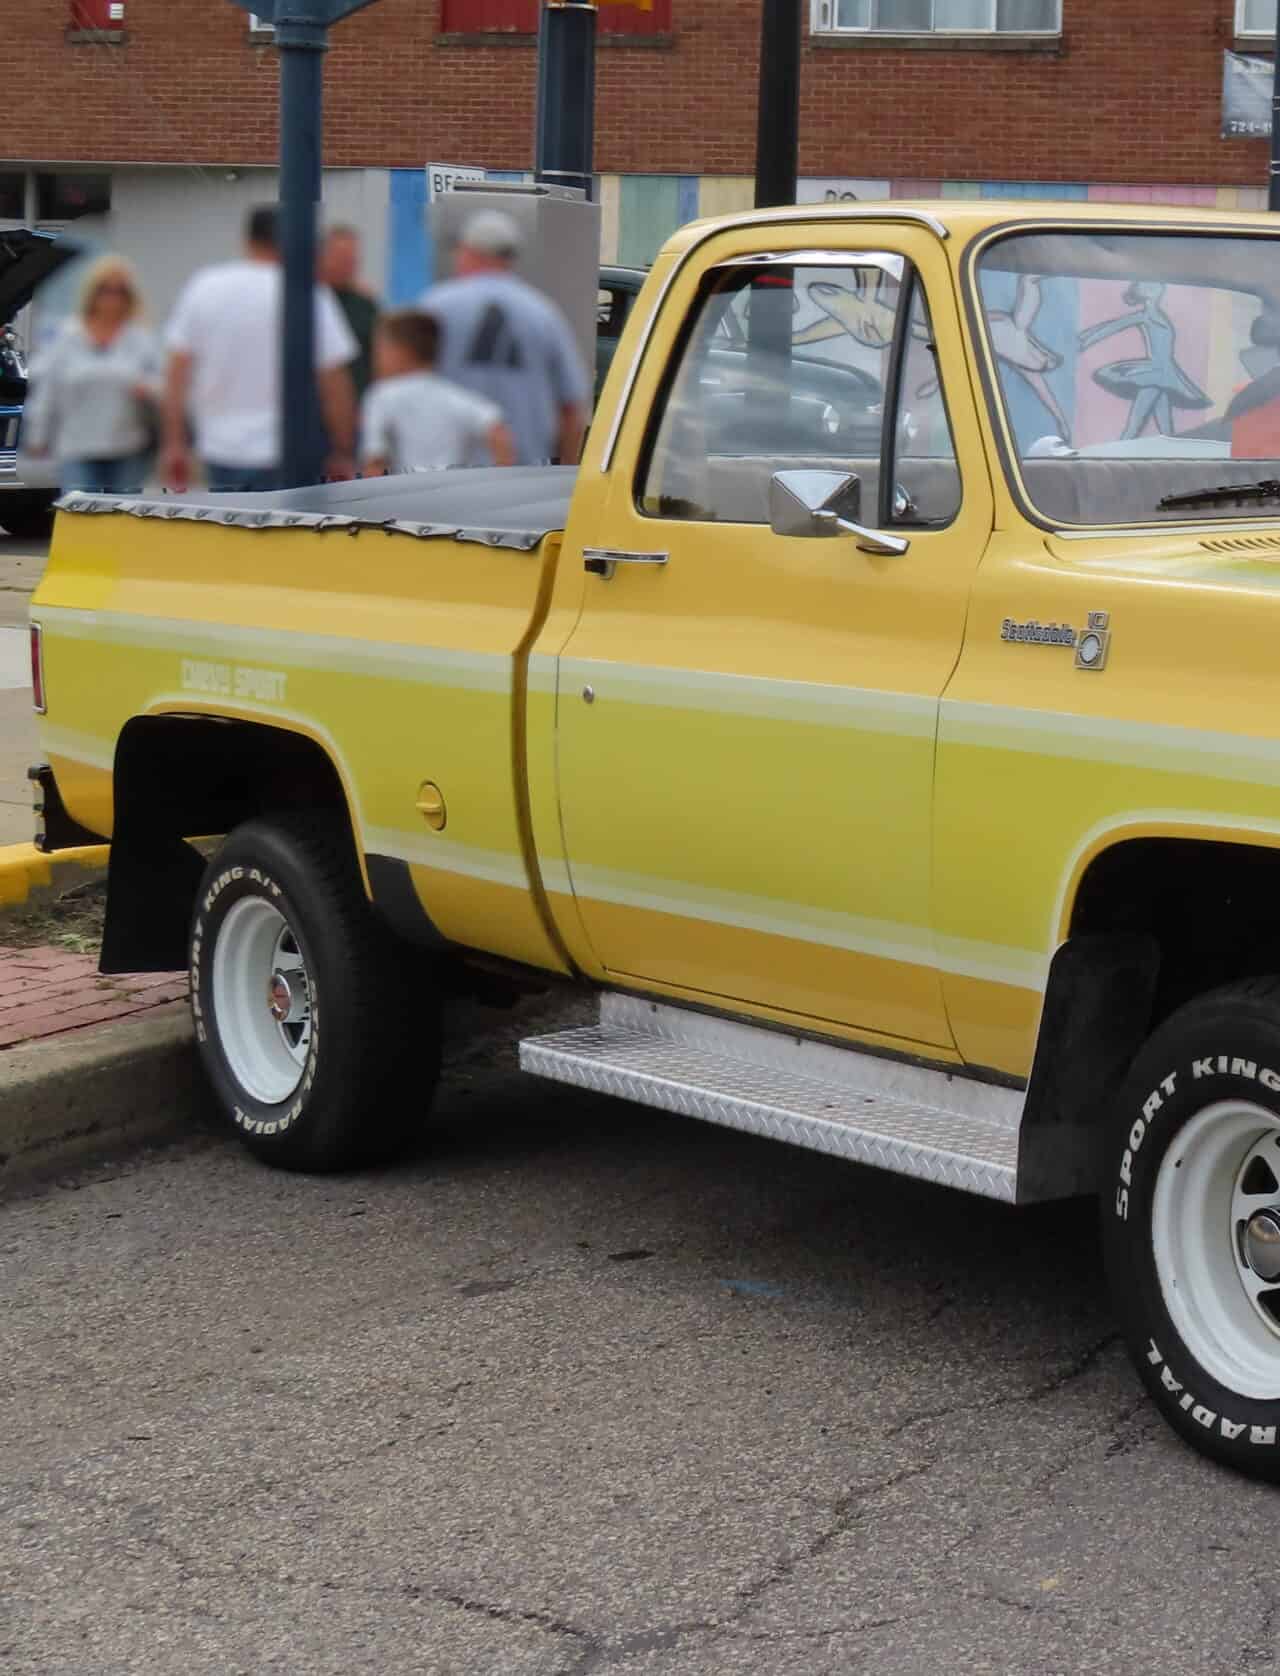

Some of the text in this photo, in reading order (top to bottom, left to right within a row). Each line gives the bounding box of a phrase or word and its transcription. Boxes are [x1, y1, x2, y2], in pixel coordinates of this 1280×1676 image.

[205, 865, 244, 912] KING
[234, 1098, 303, 1135] RADIAL
[1116, 1071, 1178, 1221] SPORT
[1147, 1337, 1277, 1445] RADIAL
